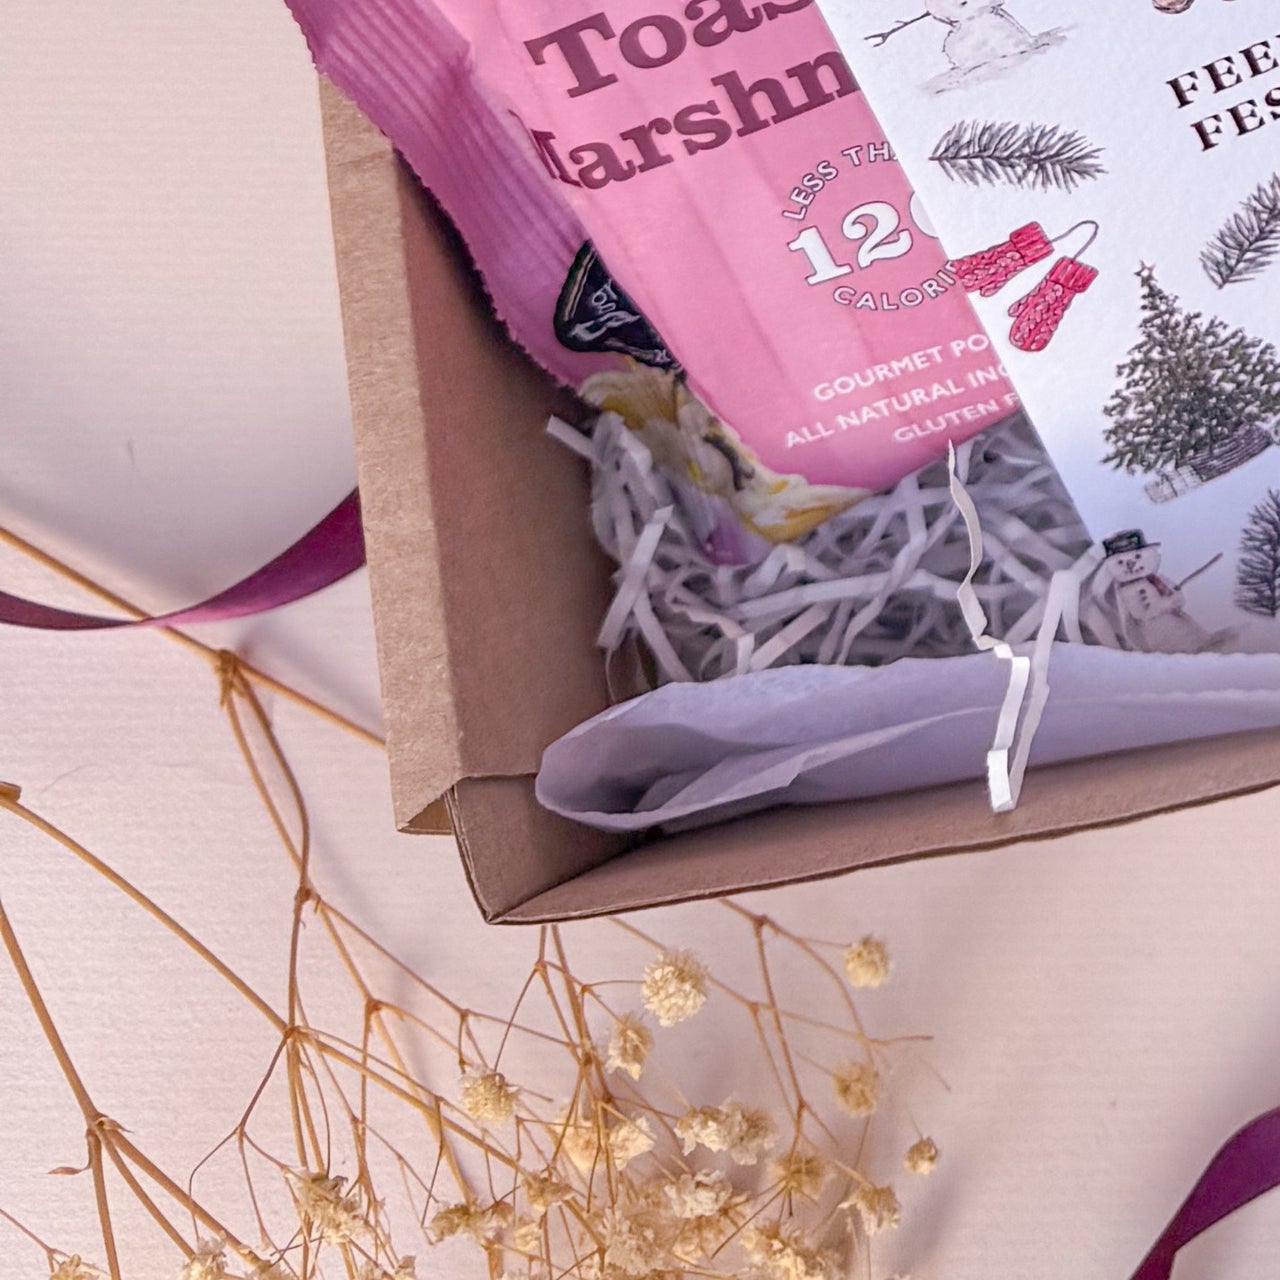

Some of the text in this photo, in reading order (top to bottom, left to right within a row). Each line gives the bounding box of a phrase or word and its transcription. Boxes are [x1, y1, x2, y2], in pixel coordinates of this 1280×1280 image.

[782, 141, 899, 222] LESS TH
[813, 344, 944, 402] GOURMET
[785, 420, 835, 450] ALL
[836, 378, 965, 431] NATURAL
[892, 399, 1000, 443] GLUTEN
